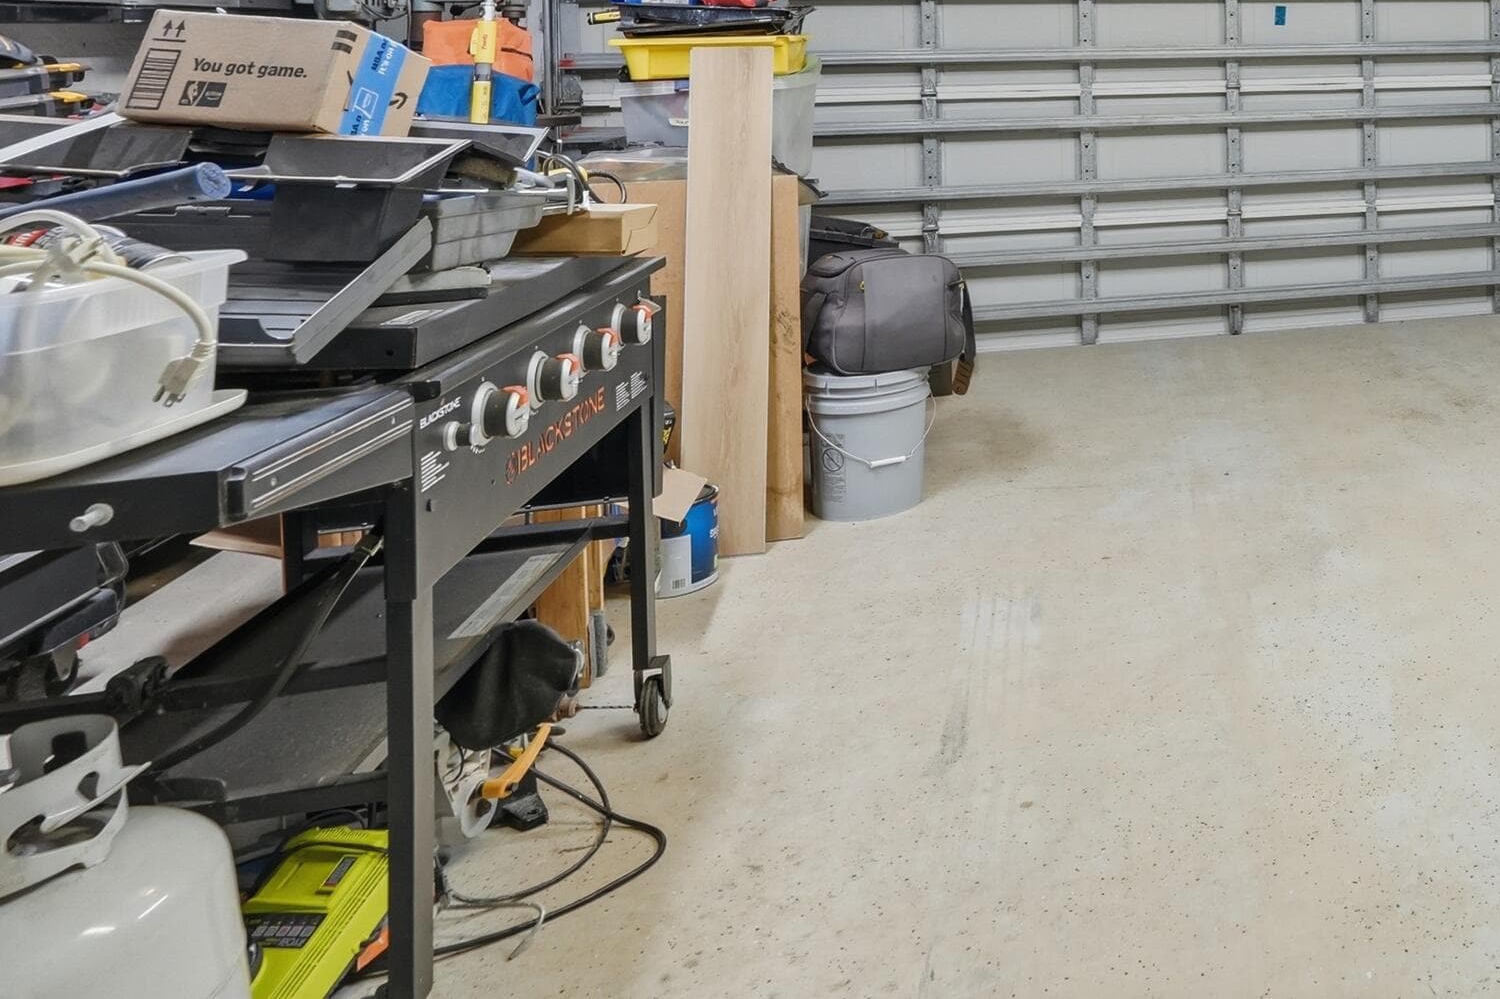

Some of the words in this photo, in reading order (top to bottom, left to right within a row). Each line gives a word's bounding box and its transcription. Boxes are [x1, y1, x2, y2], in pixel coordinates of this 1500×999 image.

[193, 58, 223, 73] You
[224, 61, 256, 76] got
[257, 65, 308, 79] game.
[516, 386, 606, 476] BLACKSTONE
